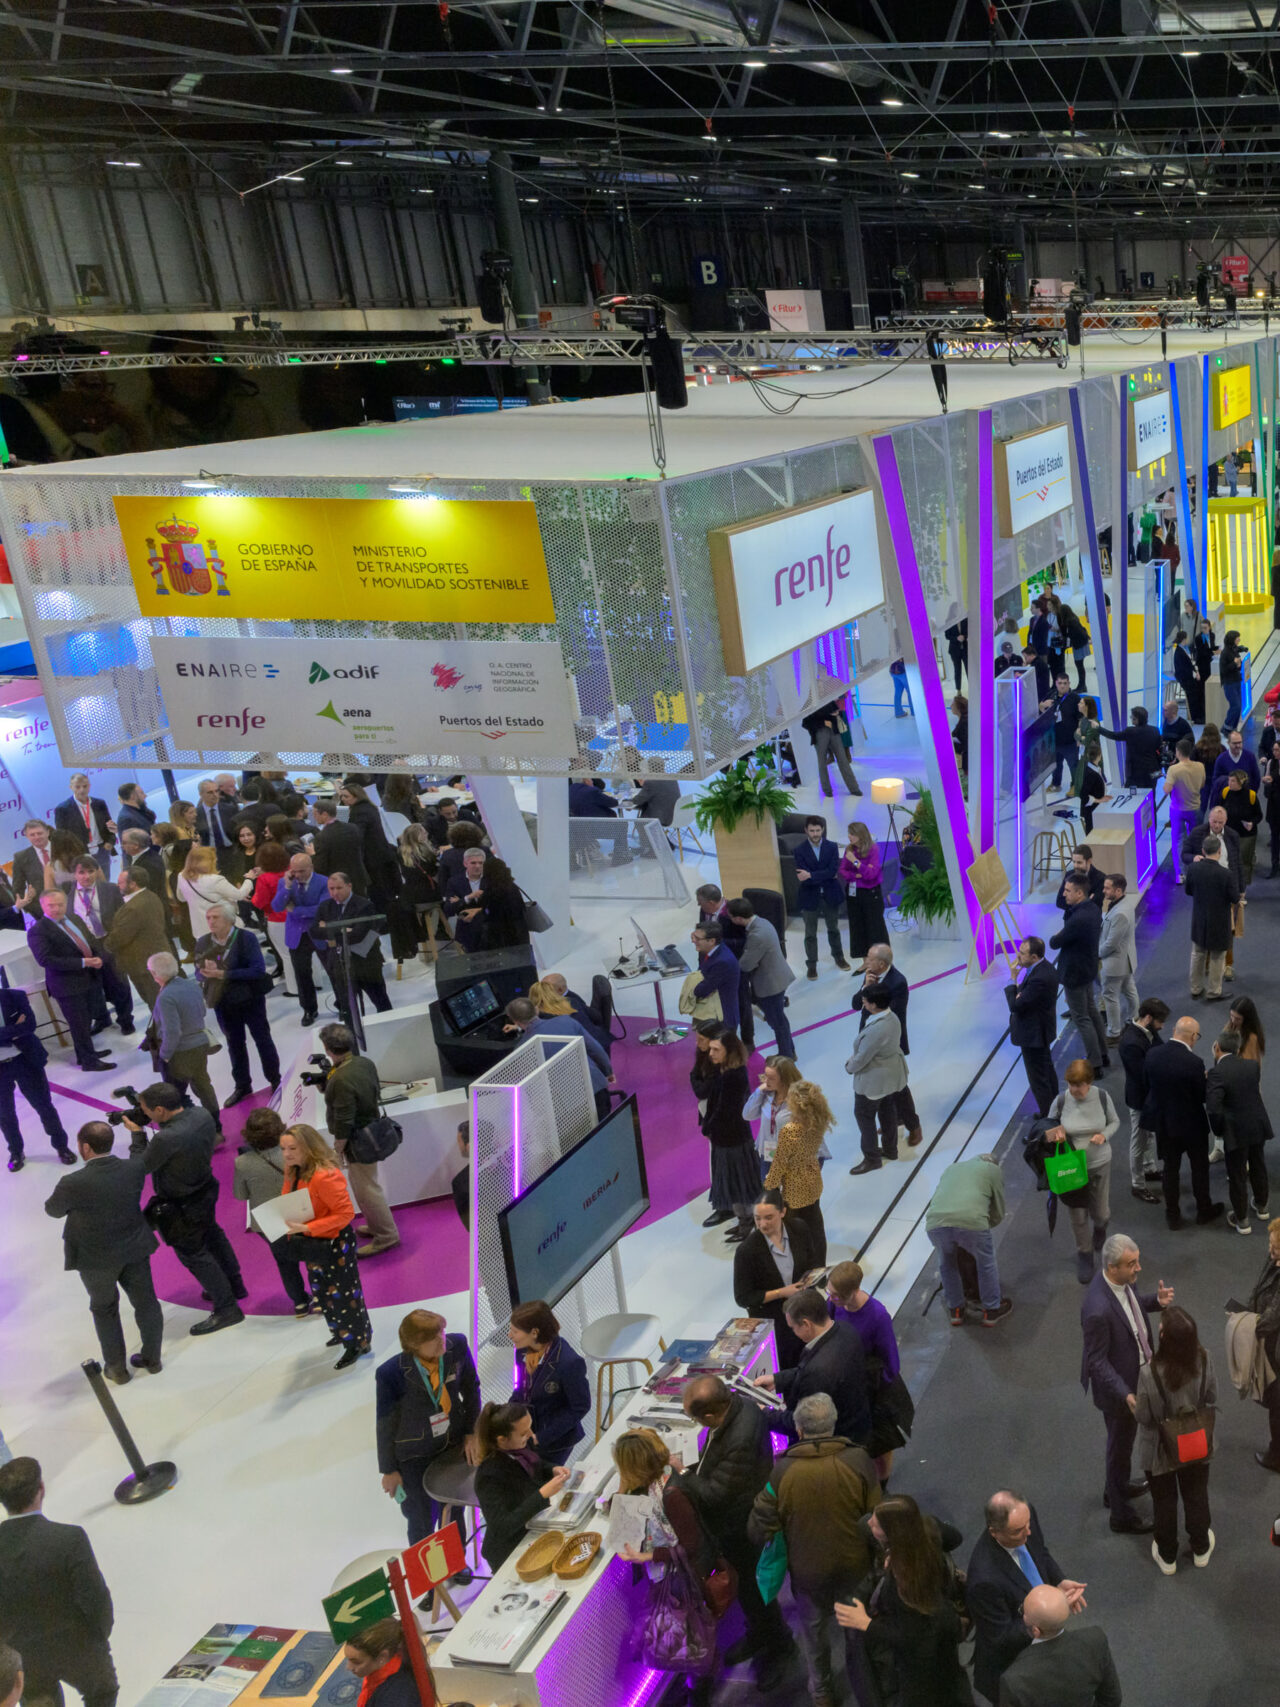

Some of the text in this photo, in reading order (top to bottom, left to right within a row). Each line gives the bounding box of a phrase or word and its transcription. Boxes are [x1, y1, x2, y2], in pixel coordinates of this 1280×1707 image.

[701, 261, 717, 285] B
[778, 304, 796, 313] Fitur
[1016, 451, 1063, 486] Puertos del Estado
[238, 544, 314, 556] GOBIERNO
[353, 545, 427, 558] MINISTERIO
[241, 557, 318, 572] DE ESPAÑA
[357, 561, 469, 574] DE TRANSPORTES
[774, 524, 850, 607] renfe
[360, 577, 530, 590] Y MOVILIDAD SOSTENIBLE
[333, 665, 380, 679] adif
[342, 707, 372, 718] aena
[197, 707, 266, 736] renfe
[439, 715, 544, 727] Puertos del Estado
[5, 717, 49, 742] renfe
[582, 1179, 612, 1210] IBERIA
[537, 1221, 567, 1255] renfe
